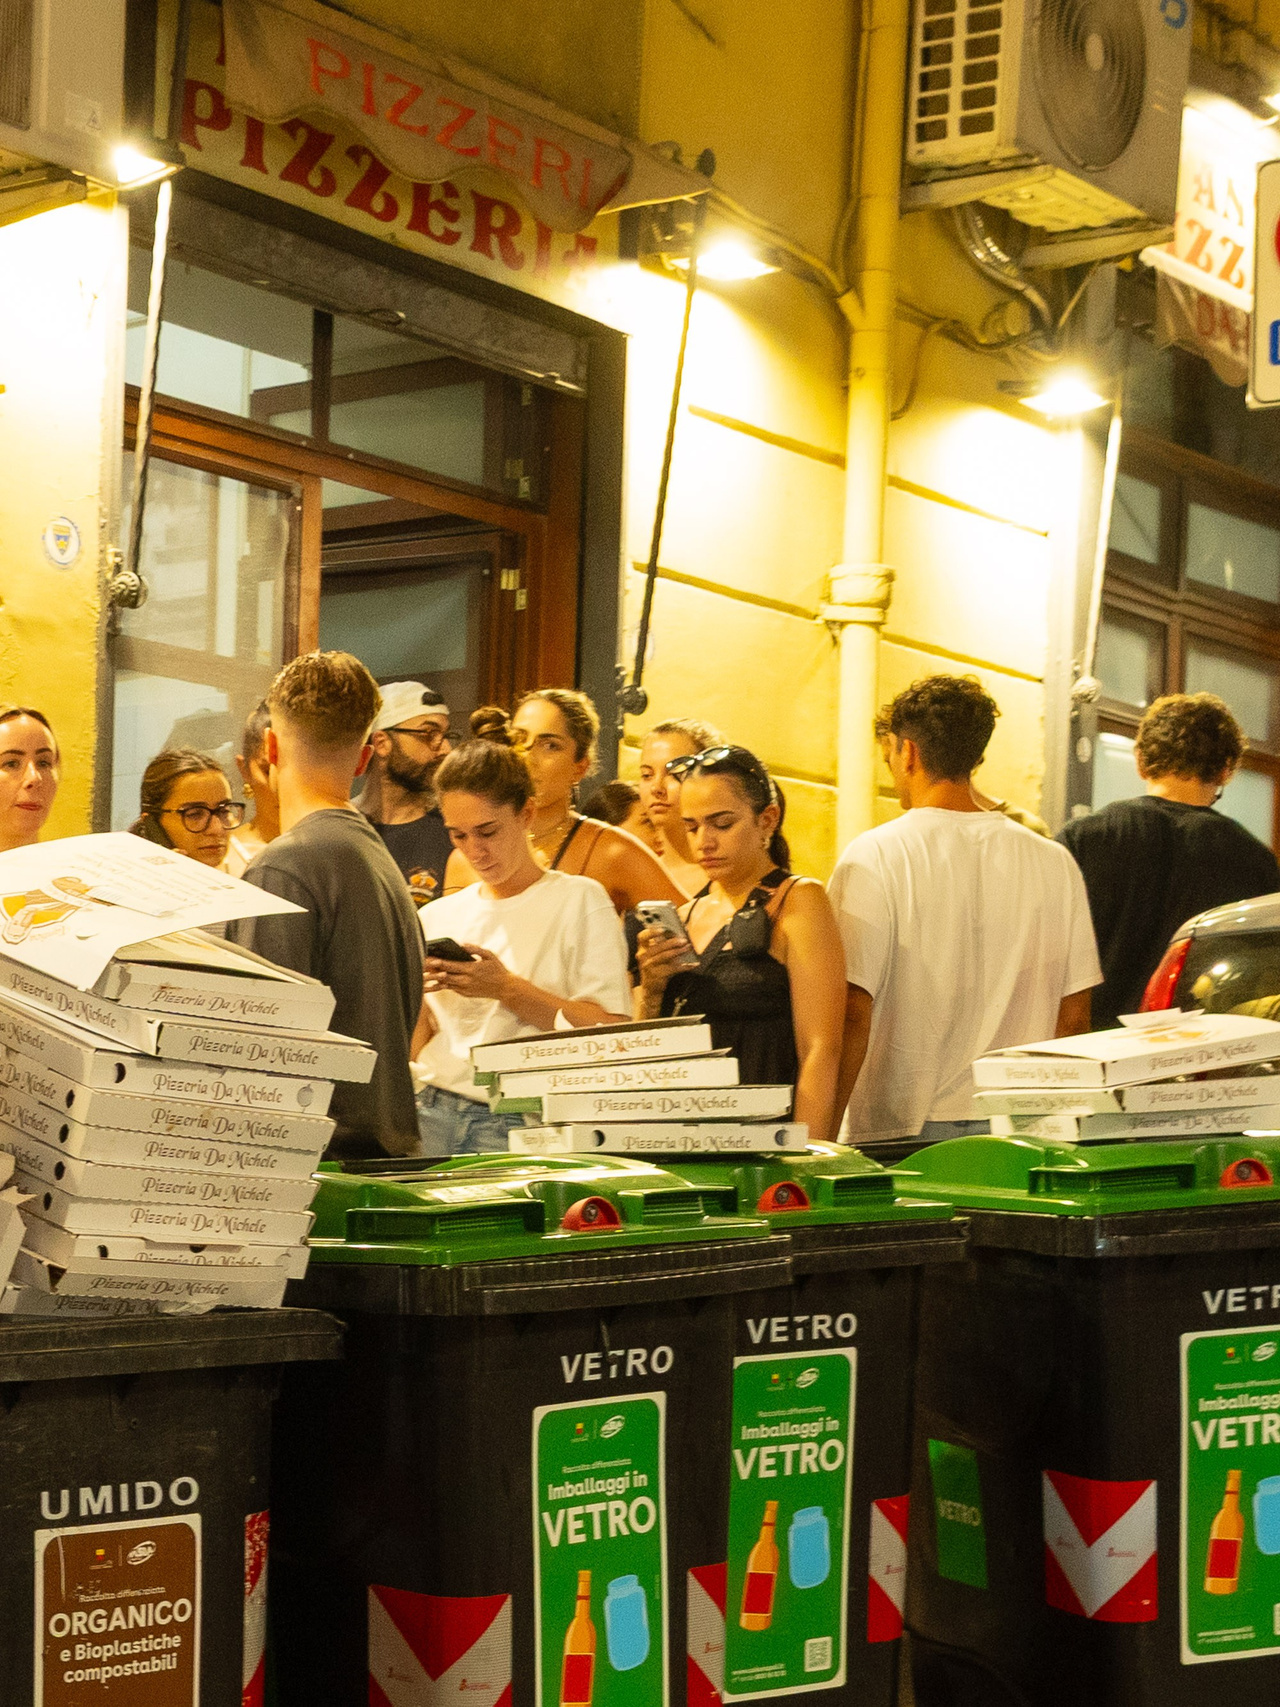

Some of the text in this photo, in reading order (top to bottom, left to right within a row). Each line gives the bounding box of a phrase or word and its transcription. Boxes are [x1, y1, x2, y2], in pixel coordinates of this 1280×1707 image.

[306, 37, 627, 209] PIZZERI
[1167, 214, 1253, 295] ZZ
[10, 973, 116, 1030] Pizzeria Da Michele
[148, 987, 280, 1015] Pizzeria Da Michele
[188, 1035, 319, 1065] Pizzeria Da Michele
[521, 1034, 661, 1061] Pizzeria Da Michele
[153, 1074, 283, 1104] Pizzeria Da Michele
[548, 1066, 688, 1088] Pizzeria Da Michele
[593, 1094, 738, 1114] Pizzeria Da Michele
[150, 1107, 289, 1139] Pizzeria Da Michele
[143, 1141, 277, 1169] Pizzeria Da Michele
[623, 1133, 751, 1151] Pizzeria Da Michele
[140, 1177, 273, 1203] Pizzeria Da Michele
[129, 1208, 267, 1234] Pizzeria Da Michele
[89, 1276, 229, 1296] Pizzeria Da Michele
[56, 1295, 110, 1311] Pizzeria
[745, 1312, 858, 1344] VETRO
[560, 1345, 674, 1384] VETRO
[1198, 1392, 1280, 1412] Imballagg
[741, 1416, 840, 1440] Imballaggi in
[733, 1438, 844, 1480] VETRO
[40, 1476, 199, 1520] UMIDO
[548, 1470, 648, 1500] Imballaggi in
[541, 1495, 656, 1547] VETRO
[937, 1497, 981, 1527] VETRO
[48, 1598, 192, 1638] ORGANICO
[60, 1634, 182, 1661] e Bioplastiche
[63, 1652, 178, 1684] compostabili
